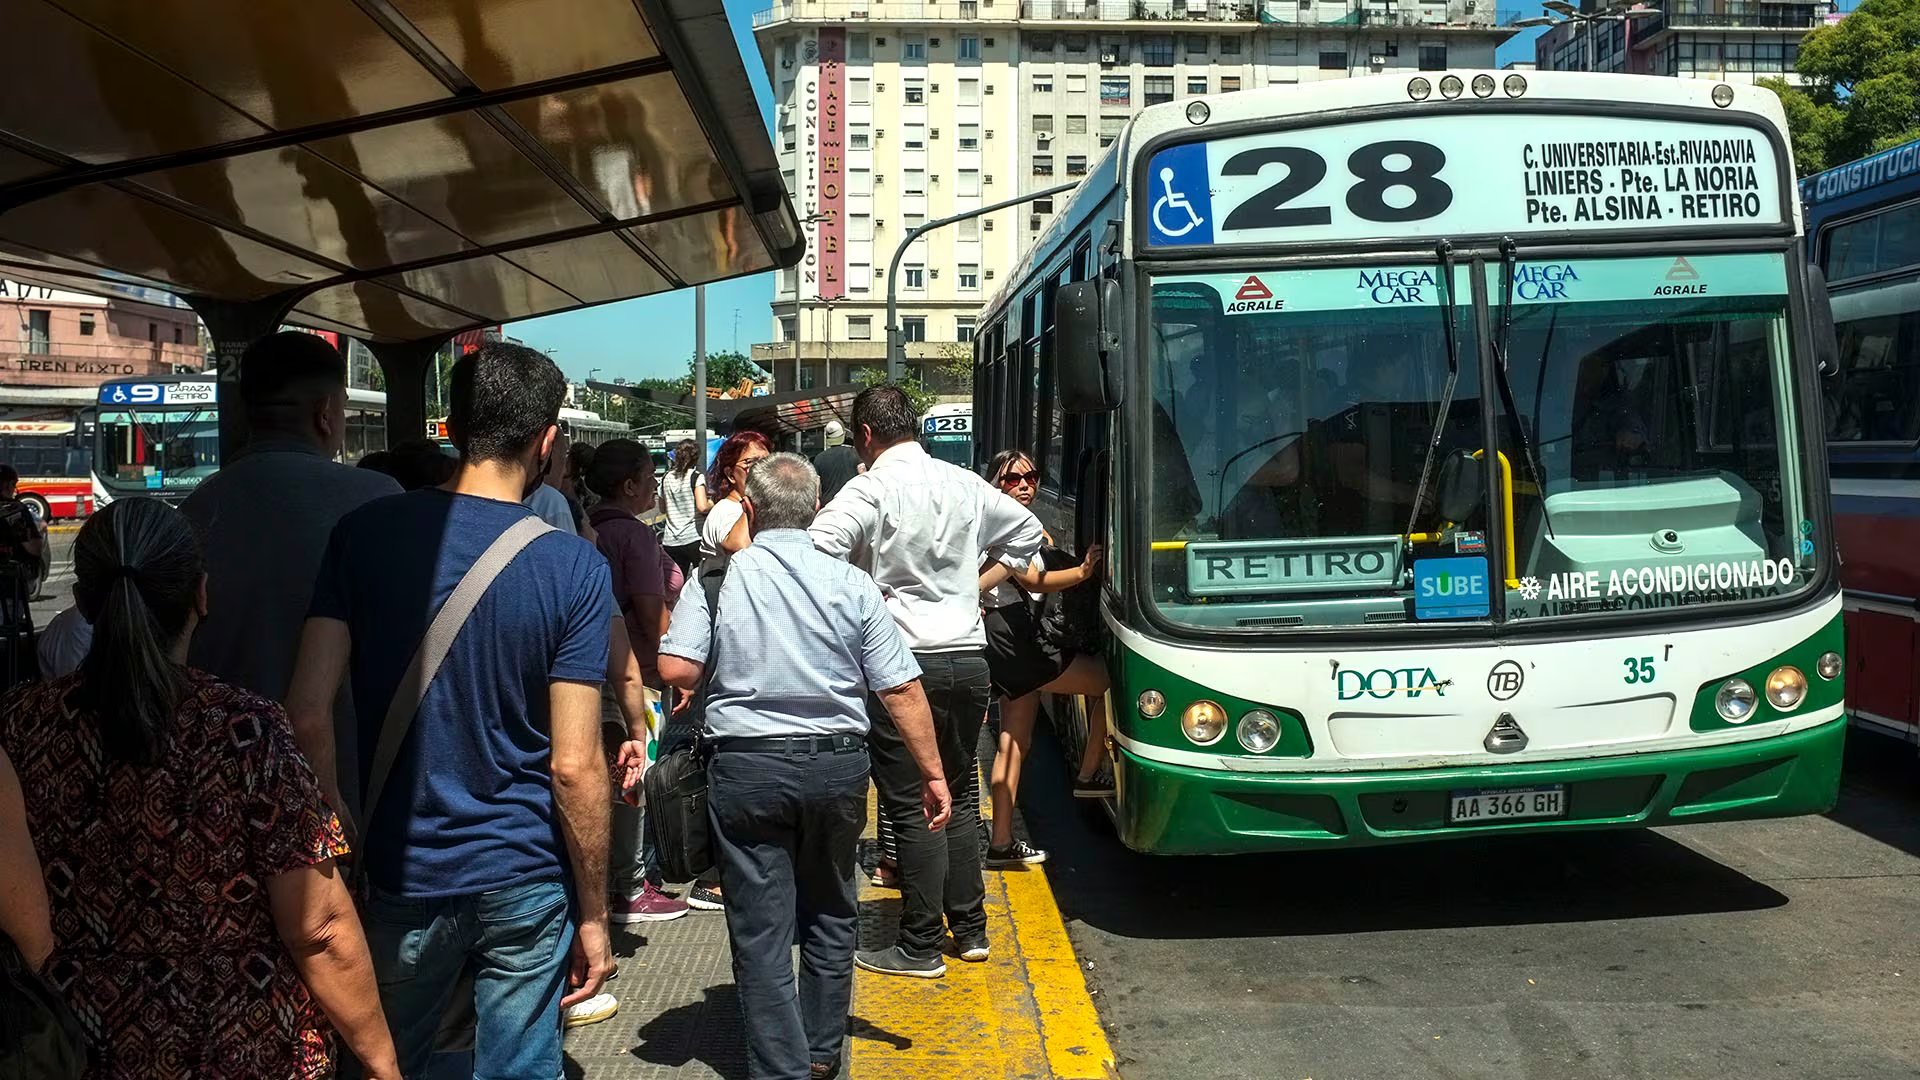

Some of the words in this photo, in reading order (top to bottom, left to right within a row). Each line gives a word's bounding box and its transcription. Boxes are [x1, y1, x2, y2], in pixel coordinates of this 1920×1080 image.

[1523, 143, 1538, 169] C.
[804, 81, 817, 284] CONSTITUCION
[1524, 168, 1603, 196] LINIERS
[1621, 168, 1658, 193] Pte.
[1664, 167, 1689, 192] LA
[1694, 166, 1759, 191] NORIA
[1816, 144, 1920, 200] CONSTITUCI
[1219, 140, 1453, 231] 28
[823, 156, 840, 283] HOTEL
[1526, 198, 1567, 224] Pte.
[1574, 195, 1662, 222] ALSINA
[1681, 192, 1760, 219] RETIRO
[1357, 269, 1435, 288] MEGA
[1513, 264, 1579, 283] MEGA
[1371, 286, 1424, 304] CAR
[1517, 281, 1568, 300] CAR
[1654, 284, 1708, 296] AGRALE
[1227, 300, 1285, 313] AGRALE
[16, 360, 67, 373] TREN
[130, 384, 160, 403] 9
[168, 385, 212, 393] CARAZA
[170, 392, 209, 400] RETIRO
[937, 418, 967, 431] 28
[1206, 551, 1385, 580] RETIRO
[1548, 571, 1600, 600] AIRE
[1607, 557, 1794, 597] ACONDICIONADO
[1421, 571, 1483, 598] SUBE
[1623, 656, 1656, 684] 35
[1337, 667, 1445, 700] DOTA
[1456, 798, 1480, 819] AA
[1488, 795, 1525, 816] 366
[1534, 793, 1559, 813] GH
